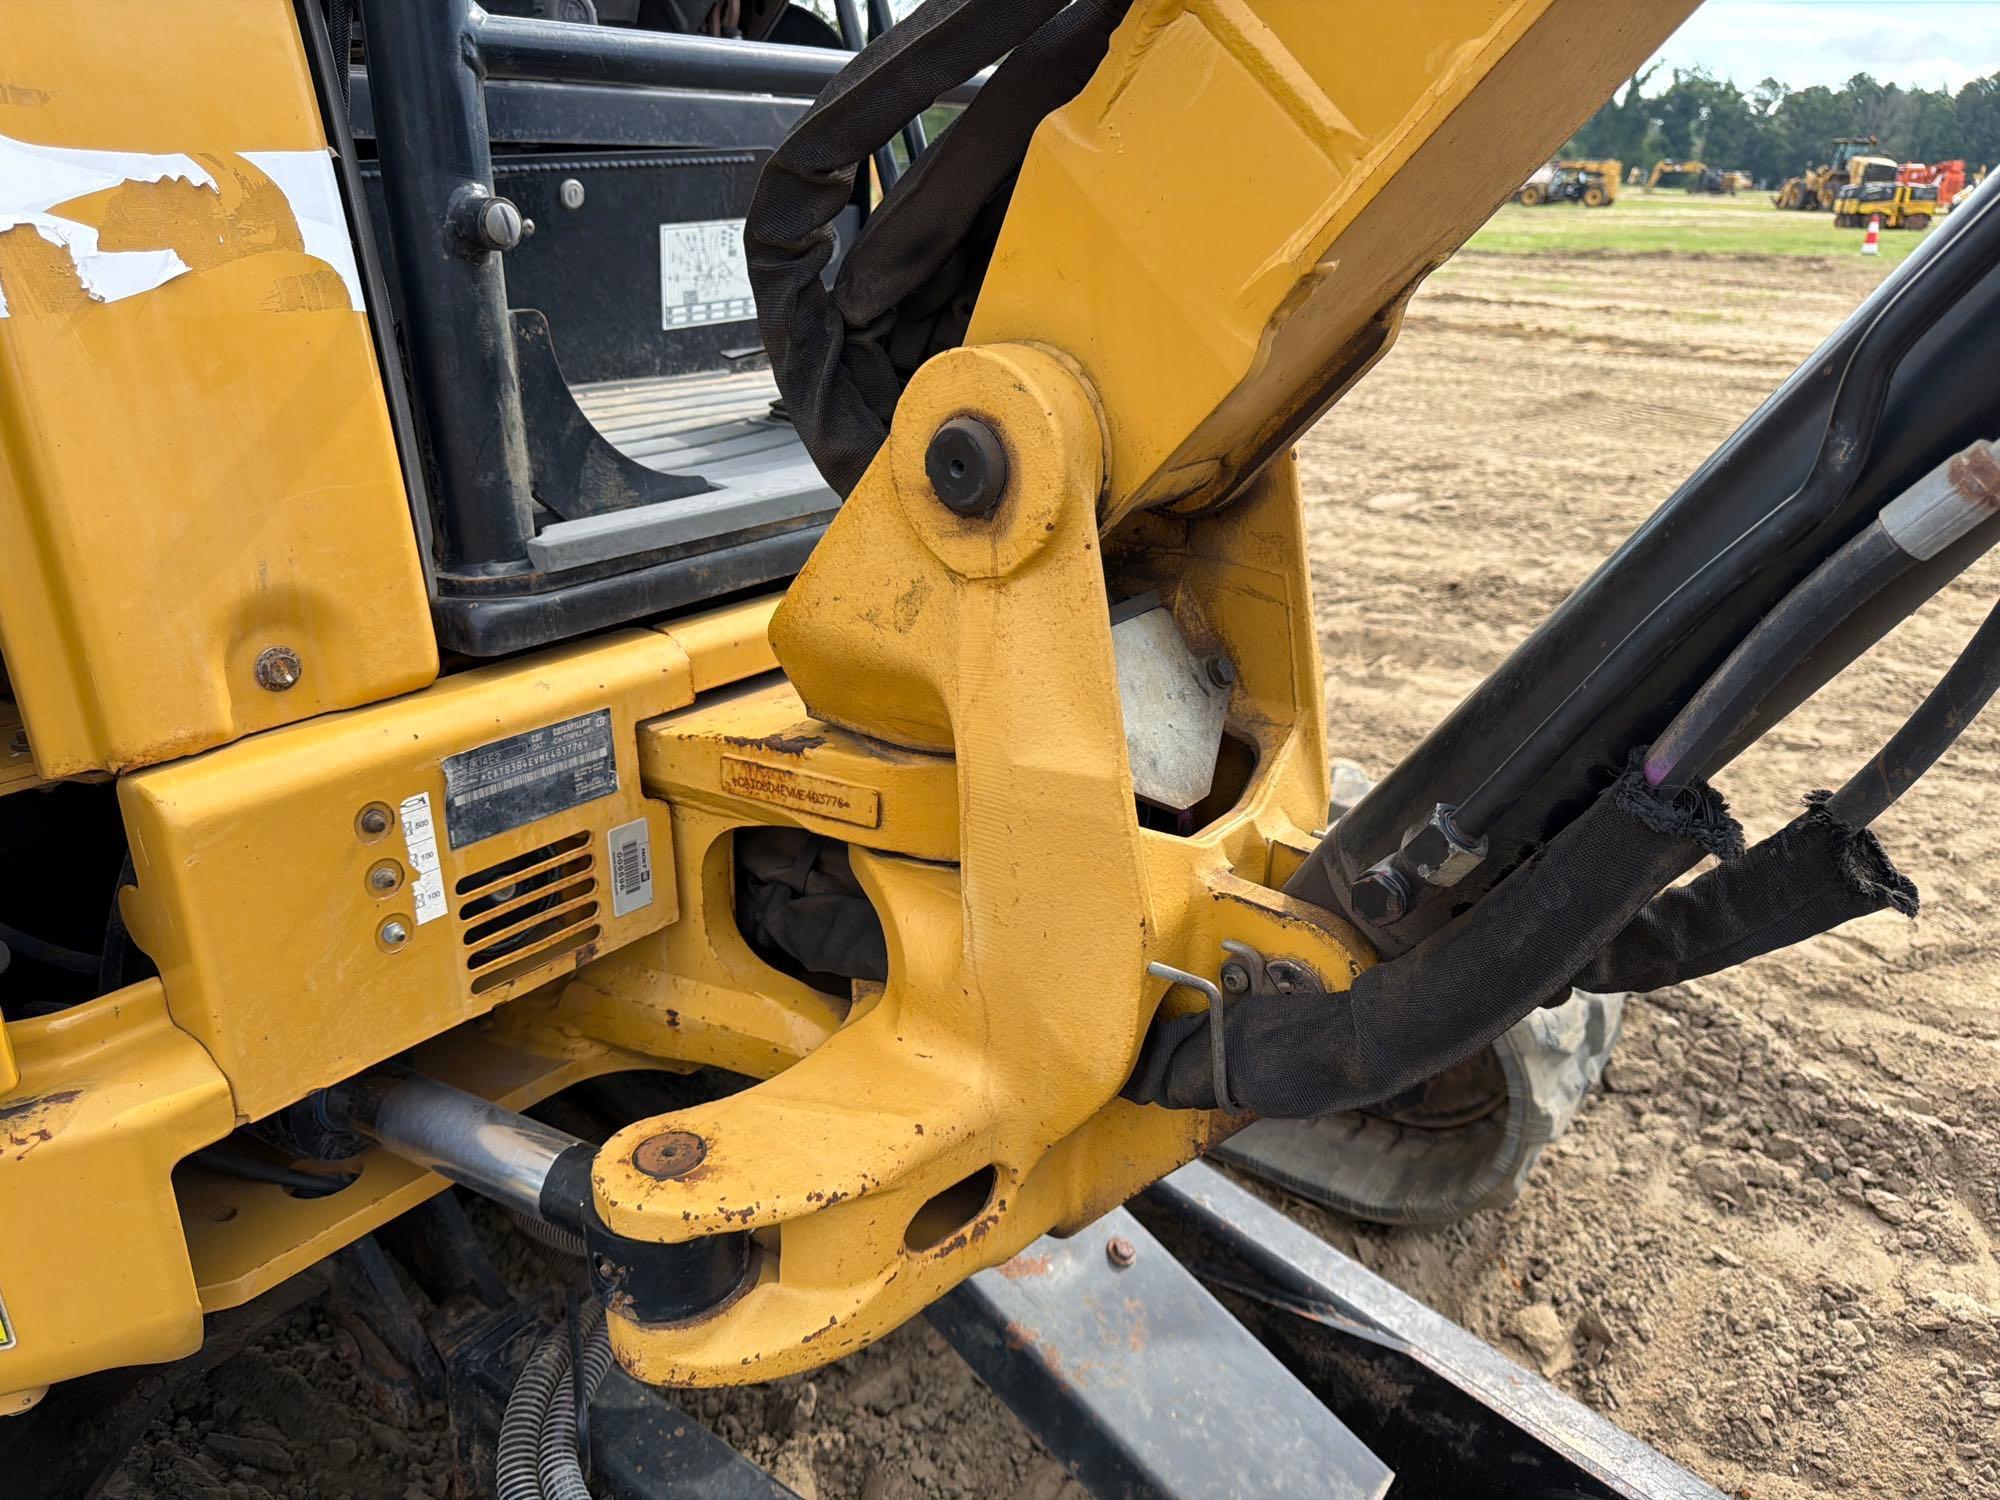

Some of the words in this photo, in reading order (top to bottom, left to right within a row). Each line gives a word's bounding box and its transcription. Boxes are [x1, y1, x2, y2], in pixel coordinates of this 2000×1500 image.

[553, 717, 592, 736] CATERPILLAR
[553, 727, 594, 744] CATERPILLAR
[421, 850, 434, 861] 100
[427, 890, 441, 901] 100
